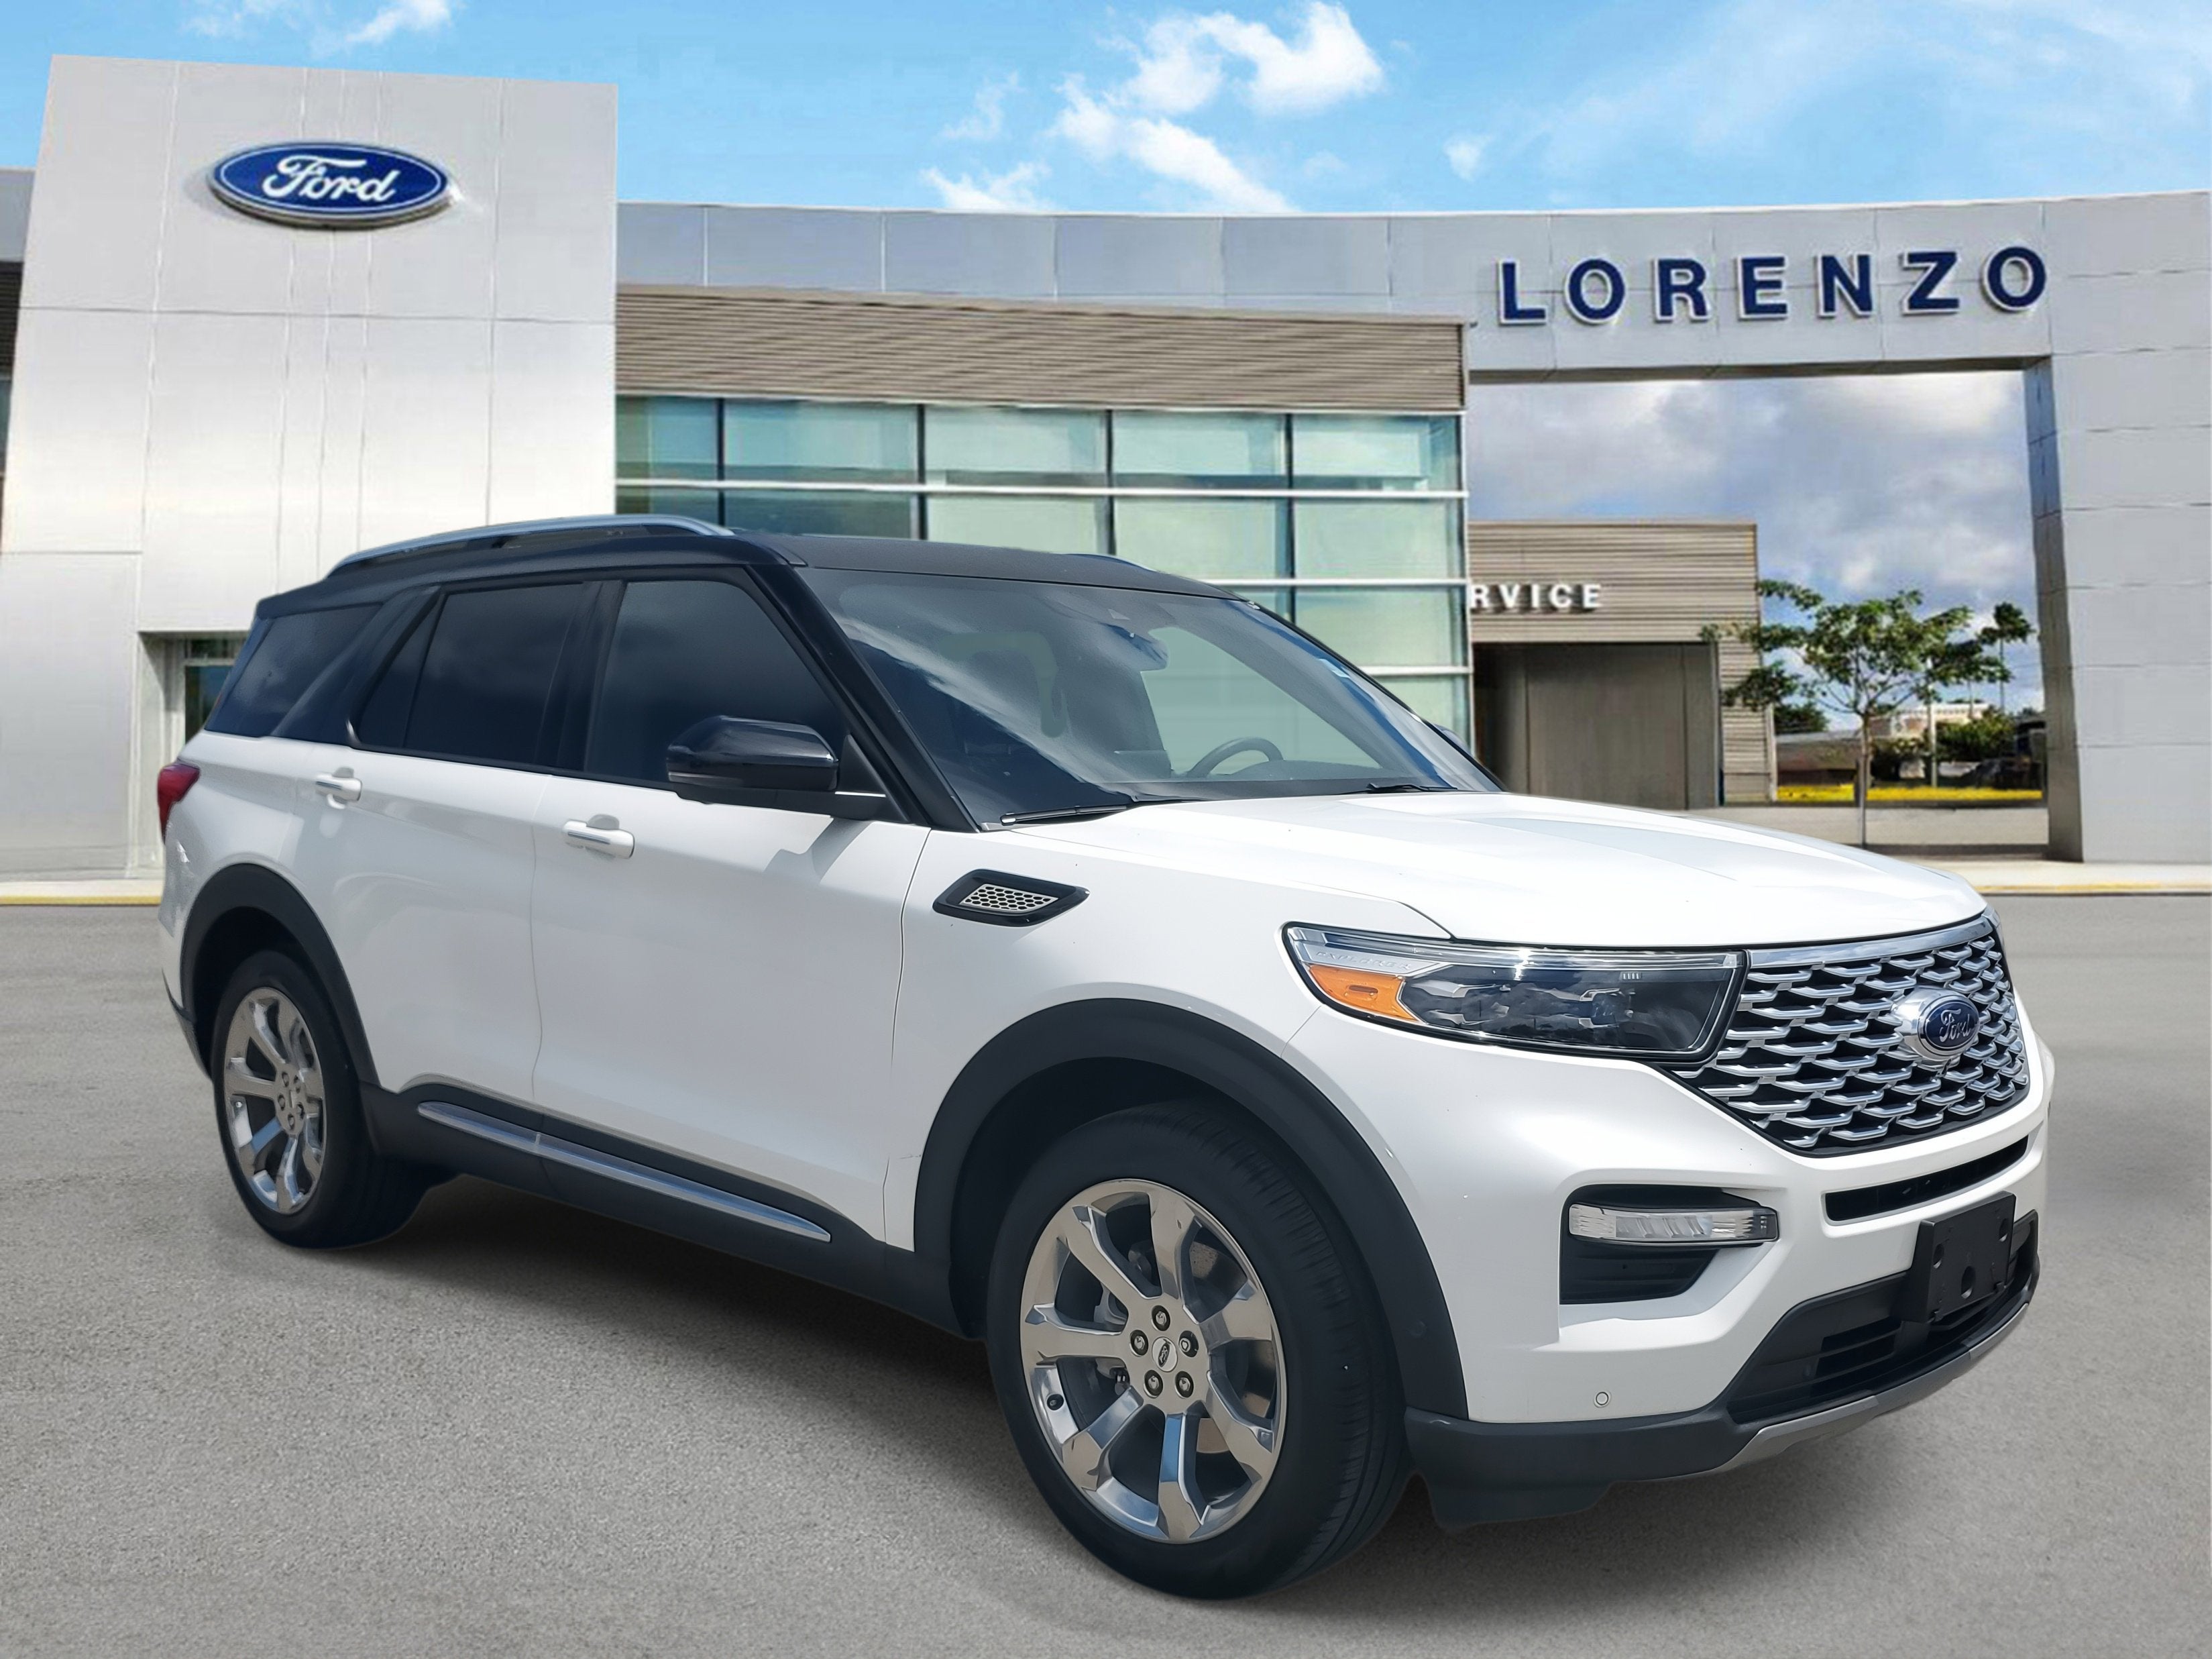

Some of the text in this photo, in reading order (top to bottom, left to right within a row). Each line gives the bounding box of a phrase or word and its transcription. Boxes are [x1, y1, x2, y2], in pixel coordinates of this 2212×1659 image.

[262, 154, 401, 201] Ford
[1499, 246, 2047, 321] LORENZO
[1939, 1008, 1971, 1042] Ford
